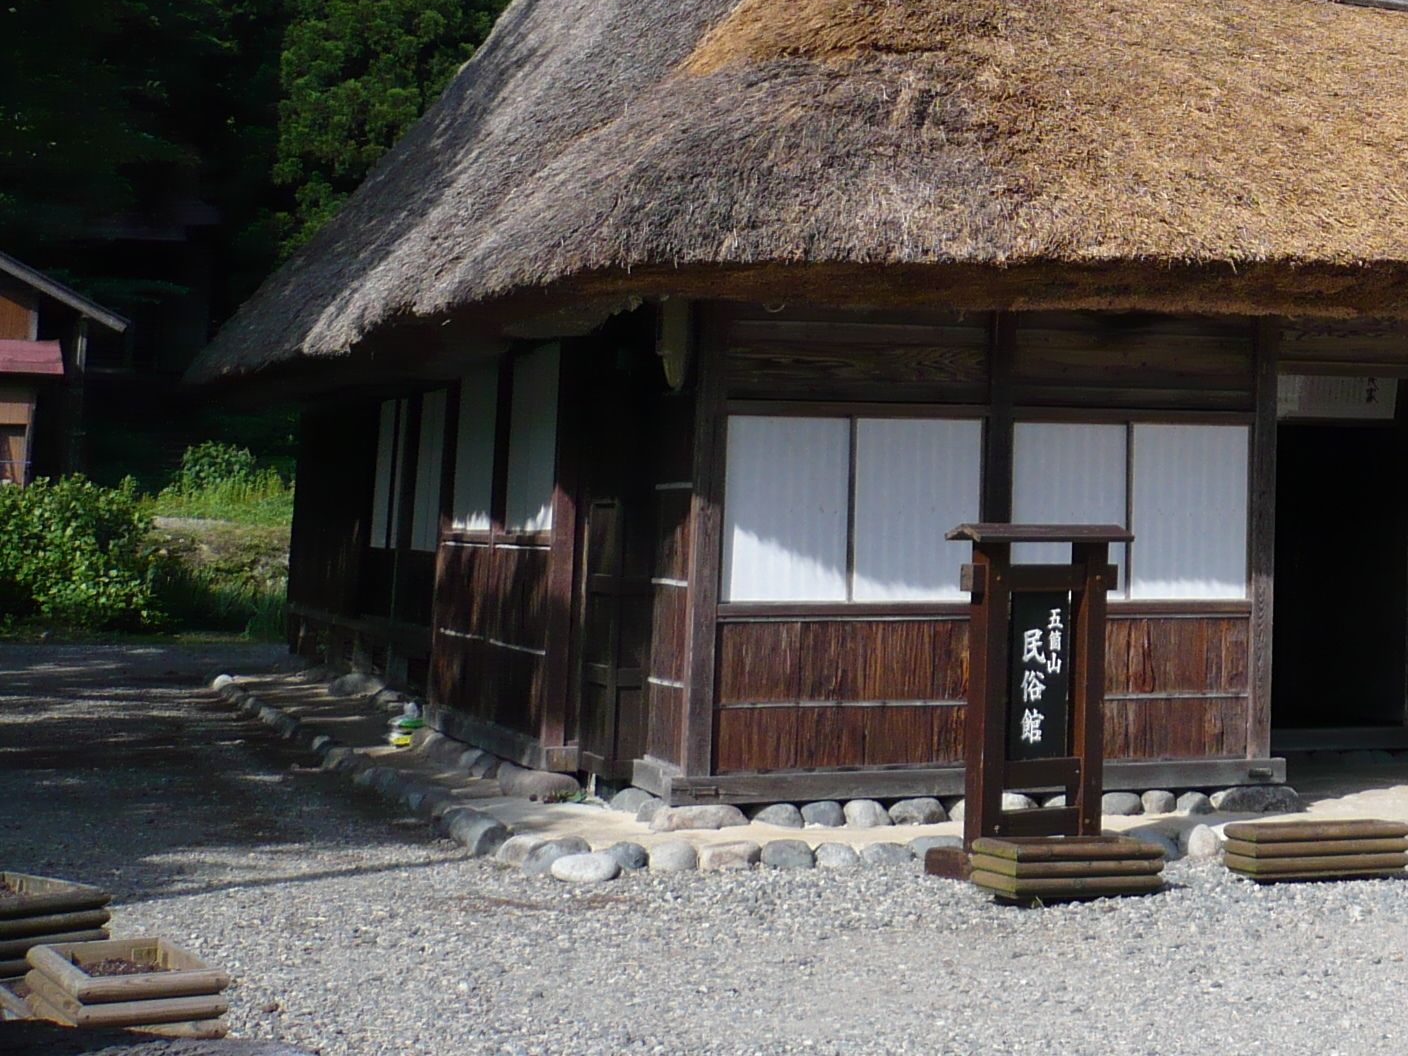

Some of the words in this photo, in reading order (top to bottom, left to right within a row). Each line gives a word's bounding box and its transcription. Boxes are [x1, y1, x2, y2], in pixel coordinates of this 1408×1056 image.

[1020, 628, 1047, 744] 民俗館
[1047, 608, 1064, 674] 五箇山
